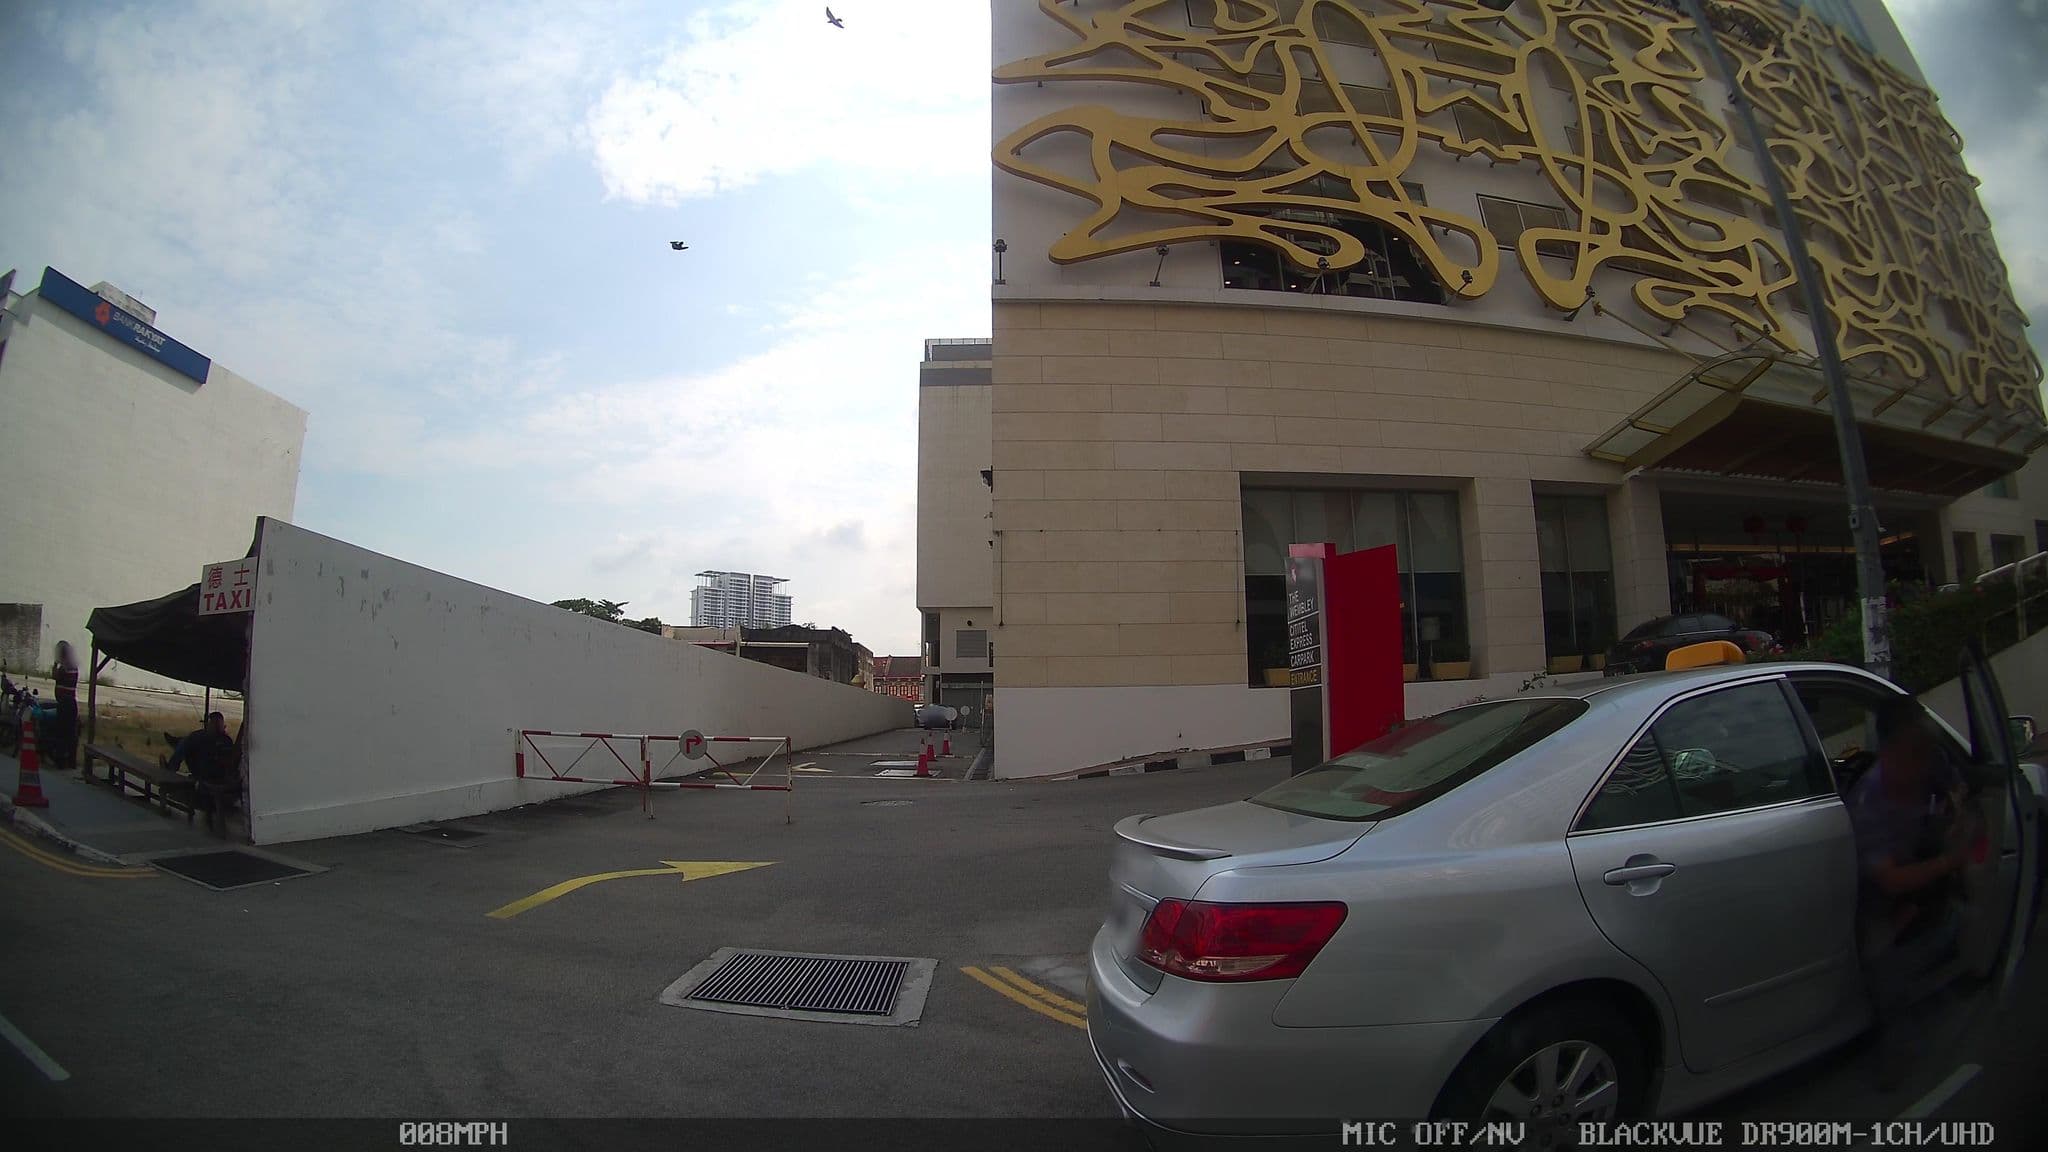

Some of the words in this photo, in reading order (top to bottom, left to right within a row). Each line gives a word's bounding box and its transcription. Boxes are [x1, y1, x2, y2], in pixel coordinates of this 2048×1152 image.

[134, 323, 166, 346] RAKYAT
[208, 563, 250, 589] 德士
[203, 588, 251, 611] TAXI
[1289, 590, 1300, 604] THE
[1288, 597, 1315, 618] WEMBLEY
[1289, 621, 1308, 637] CITITEL
[1290, 632, 1313, 650] EXPRESS
[1290, 650, 1315, 667] CARPARK
[1290, 669, 1318, 686] ENTRANCE
